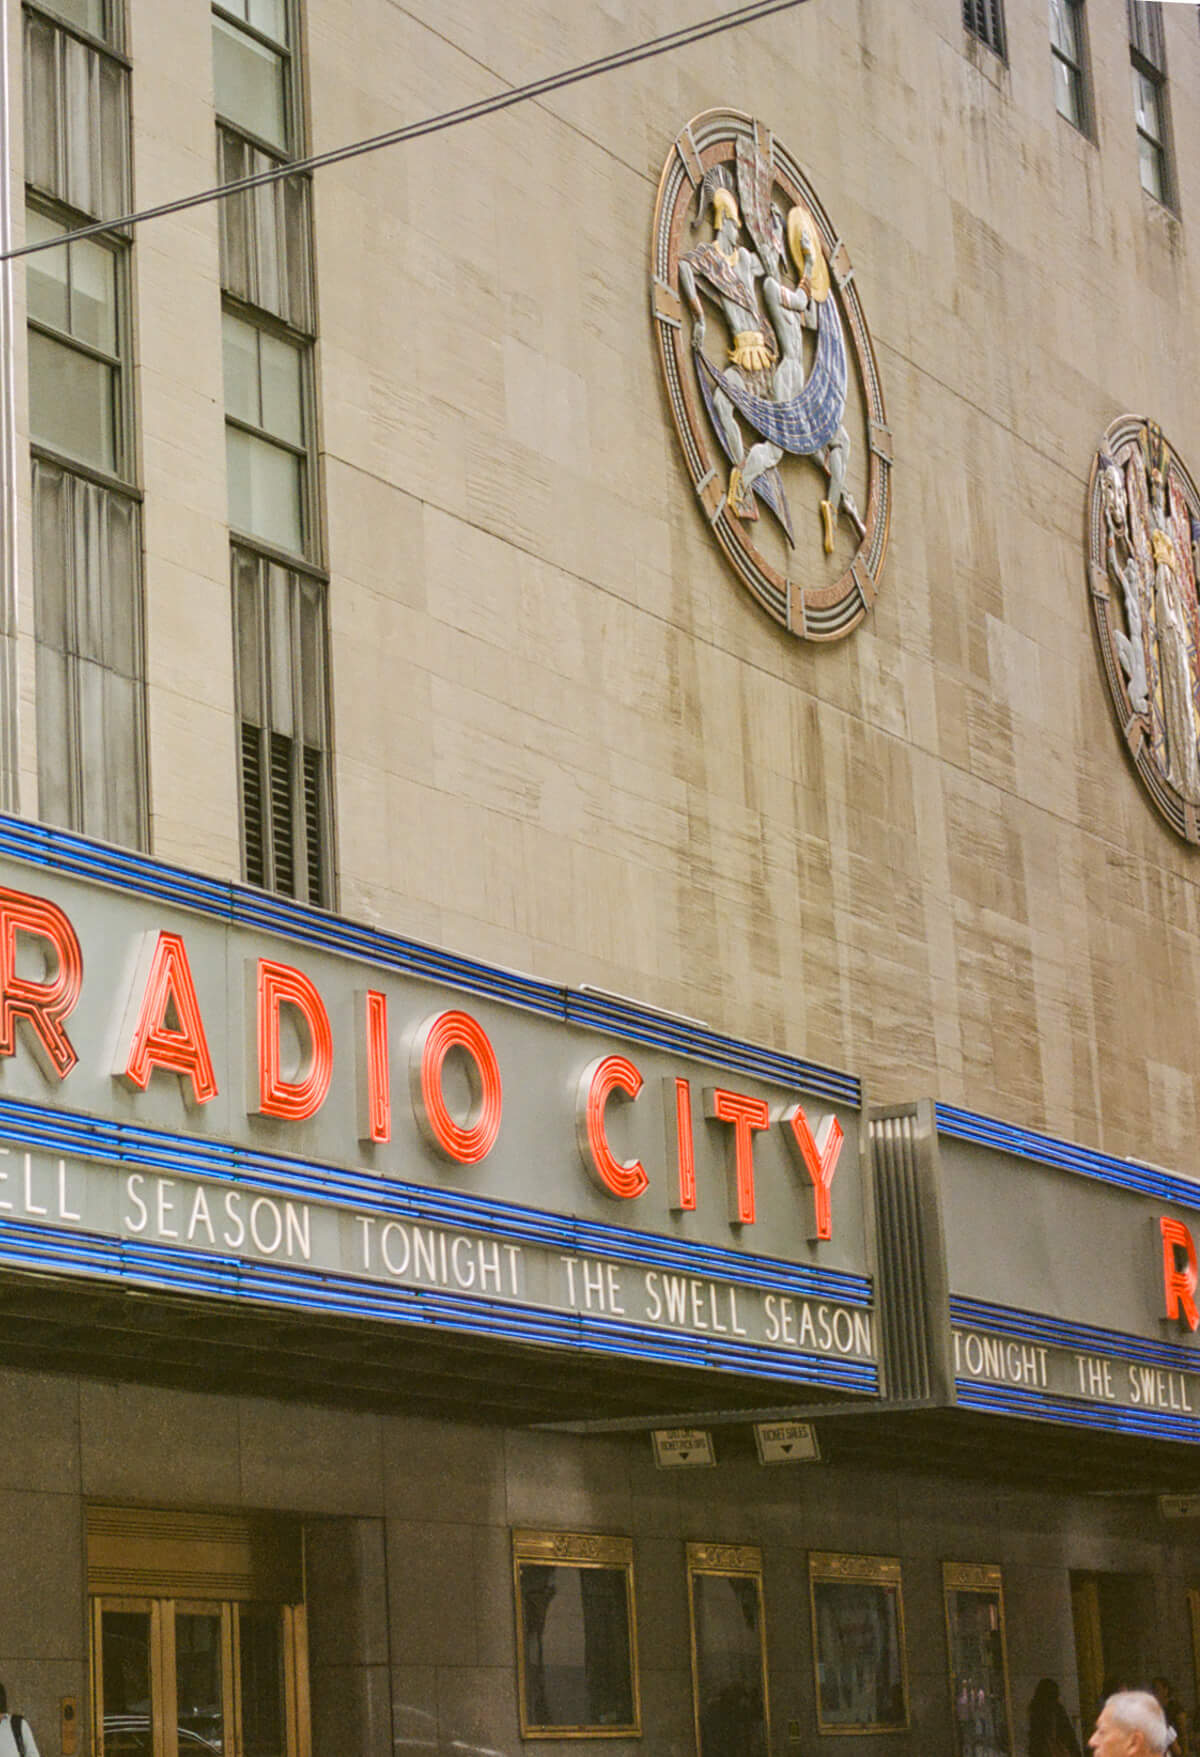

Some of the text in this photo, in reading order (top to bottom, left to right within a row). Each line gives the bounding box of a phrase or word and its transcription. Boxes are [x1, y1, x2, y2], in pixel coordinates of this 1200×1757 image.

[578, 1054, 845, 1242] CITY
[123, 1173, 312, 1260] SEASON
[355, 1215, 521, 1295] TONIGHT
[560, 1256, 626, 1316] THE
[645, 1271, 747, 1337] SWELL
[764, 1294, 873, 1357] SEASON
[951, 1329, 1193, 1412] TONIGHT THE SWELL
